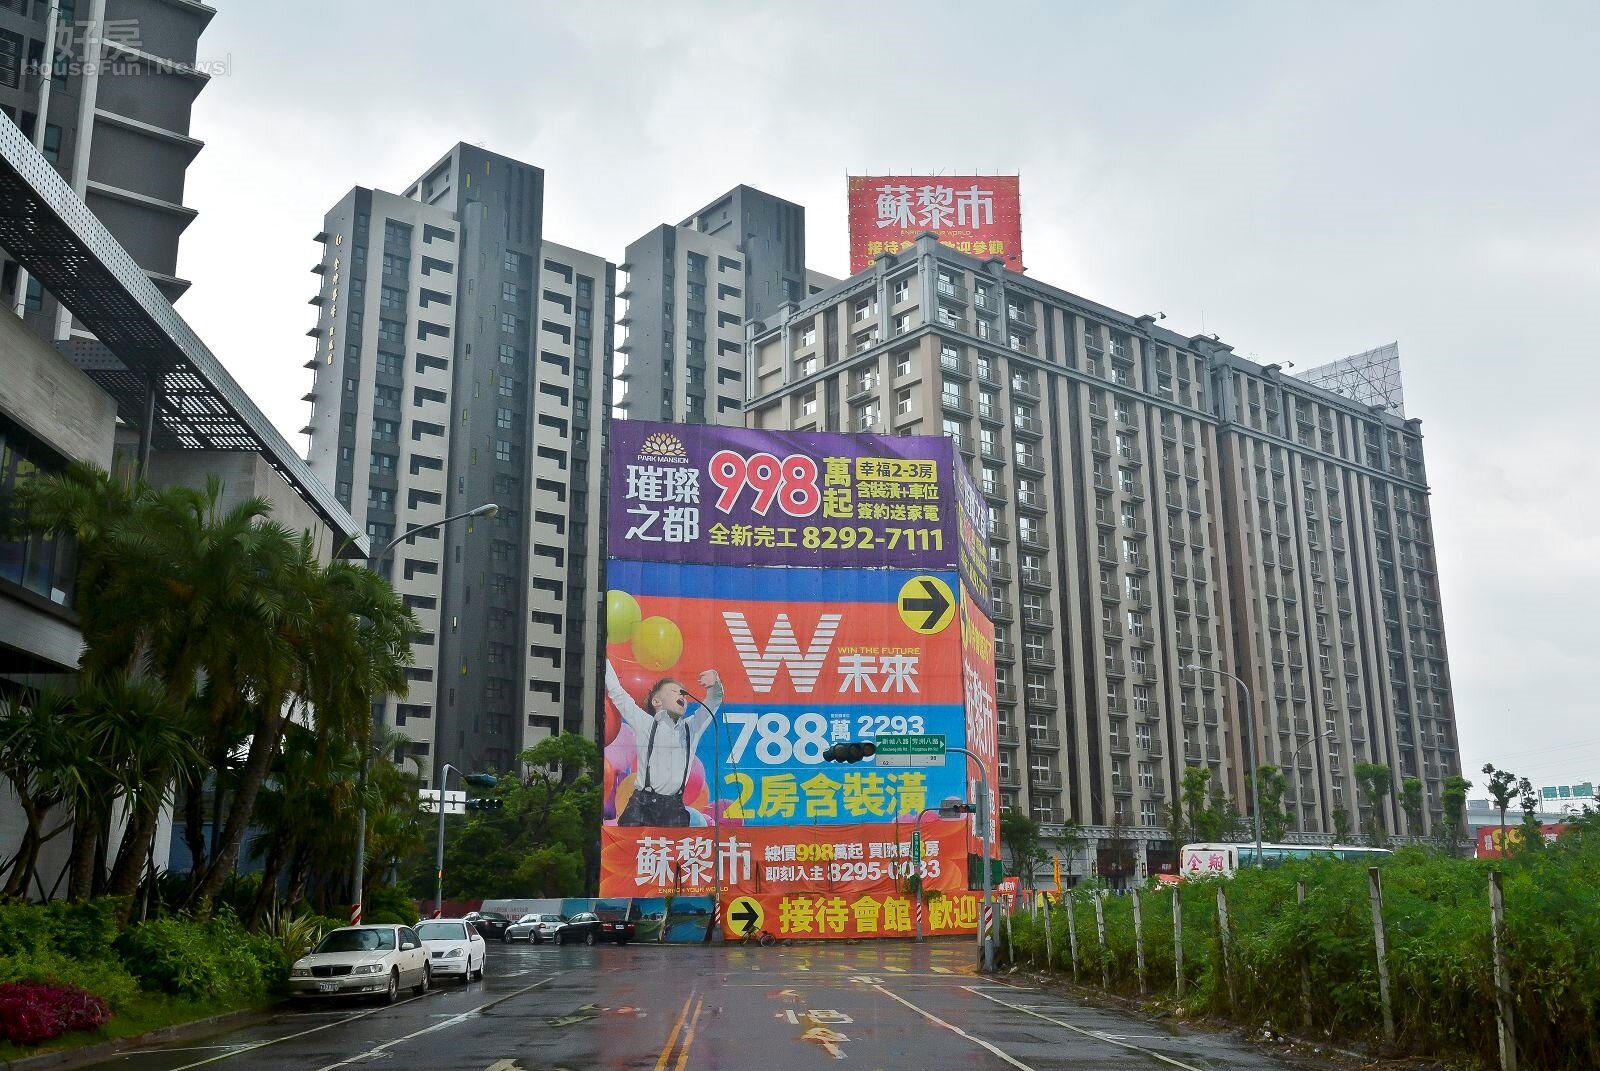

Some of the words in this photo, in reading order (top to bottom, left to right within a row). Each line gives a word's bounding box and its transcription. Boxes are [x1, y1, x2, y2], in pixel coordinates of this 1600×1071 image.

[875, 185, 994, 229] 蘇黎市
[657, 456, 689, 464] MANSION
[860, 461, 933, 478] 幸福2-3房
[626, 465, 700, 504] 璀璨
[708, 449, 821, 518] 998
[823, 456, 854, 519] 萬起
[856, 481, 939, 500] 含裝潢+車位
[625, 503, 700, 543] 之都
[857, 502, 940, 522] 簽約送家電
[708, 522, 797, 548] 全新完工
[802, 526, 943, 551] 8292-7111
[722, 611, 842, 693] W
[838, 646, 858, 654] WIN
[881, 647, 921, 655] FUTURE
[837, 654, 919, 693] 未來
[722, 712, 829, 765] 788
[857, 715, 925, 737] 2293
[722, 772, 927, 820] 2房含裝潢
[634, 836, 752, 887] 蘇黎市
[764, 842, 864, 862] 總價998萬起
[765, 865, 825, 882] 即刻入主
[778, 895, 912, 934] 接待會館
[928, 895, 997, 931] 歡迎
